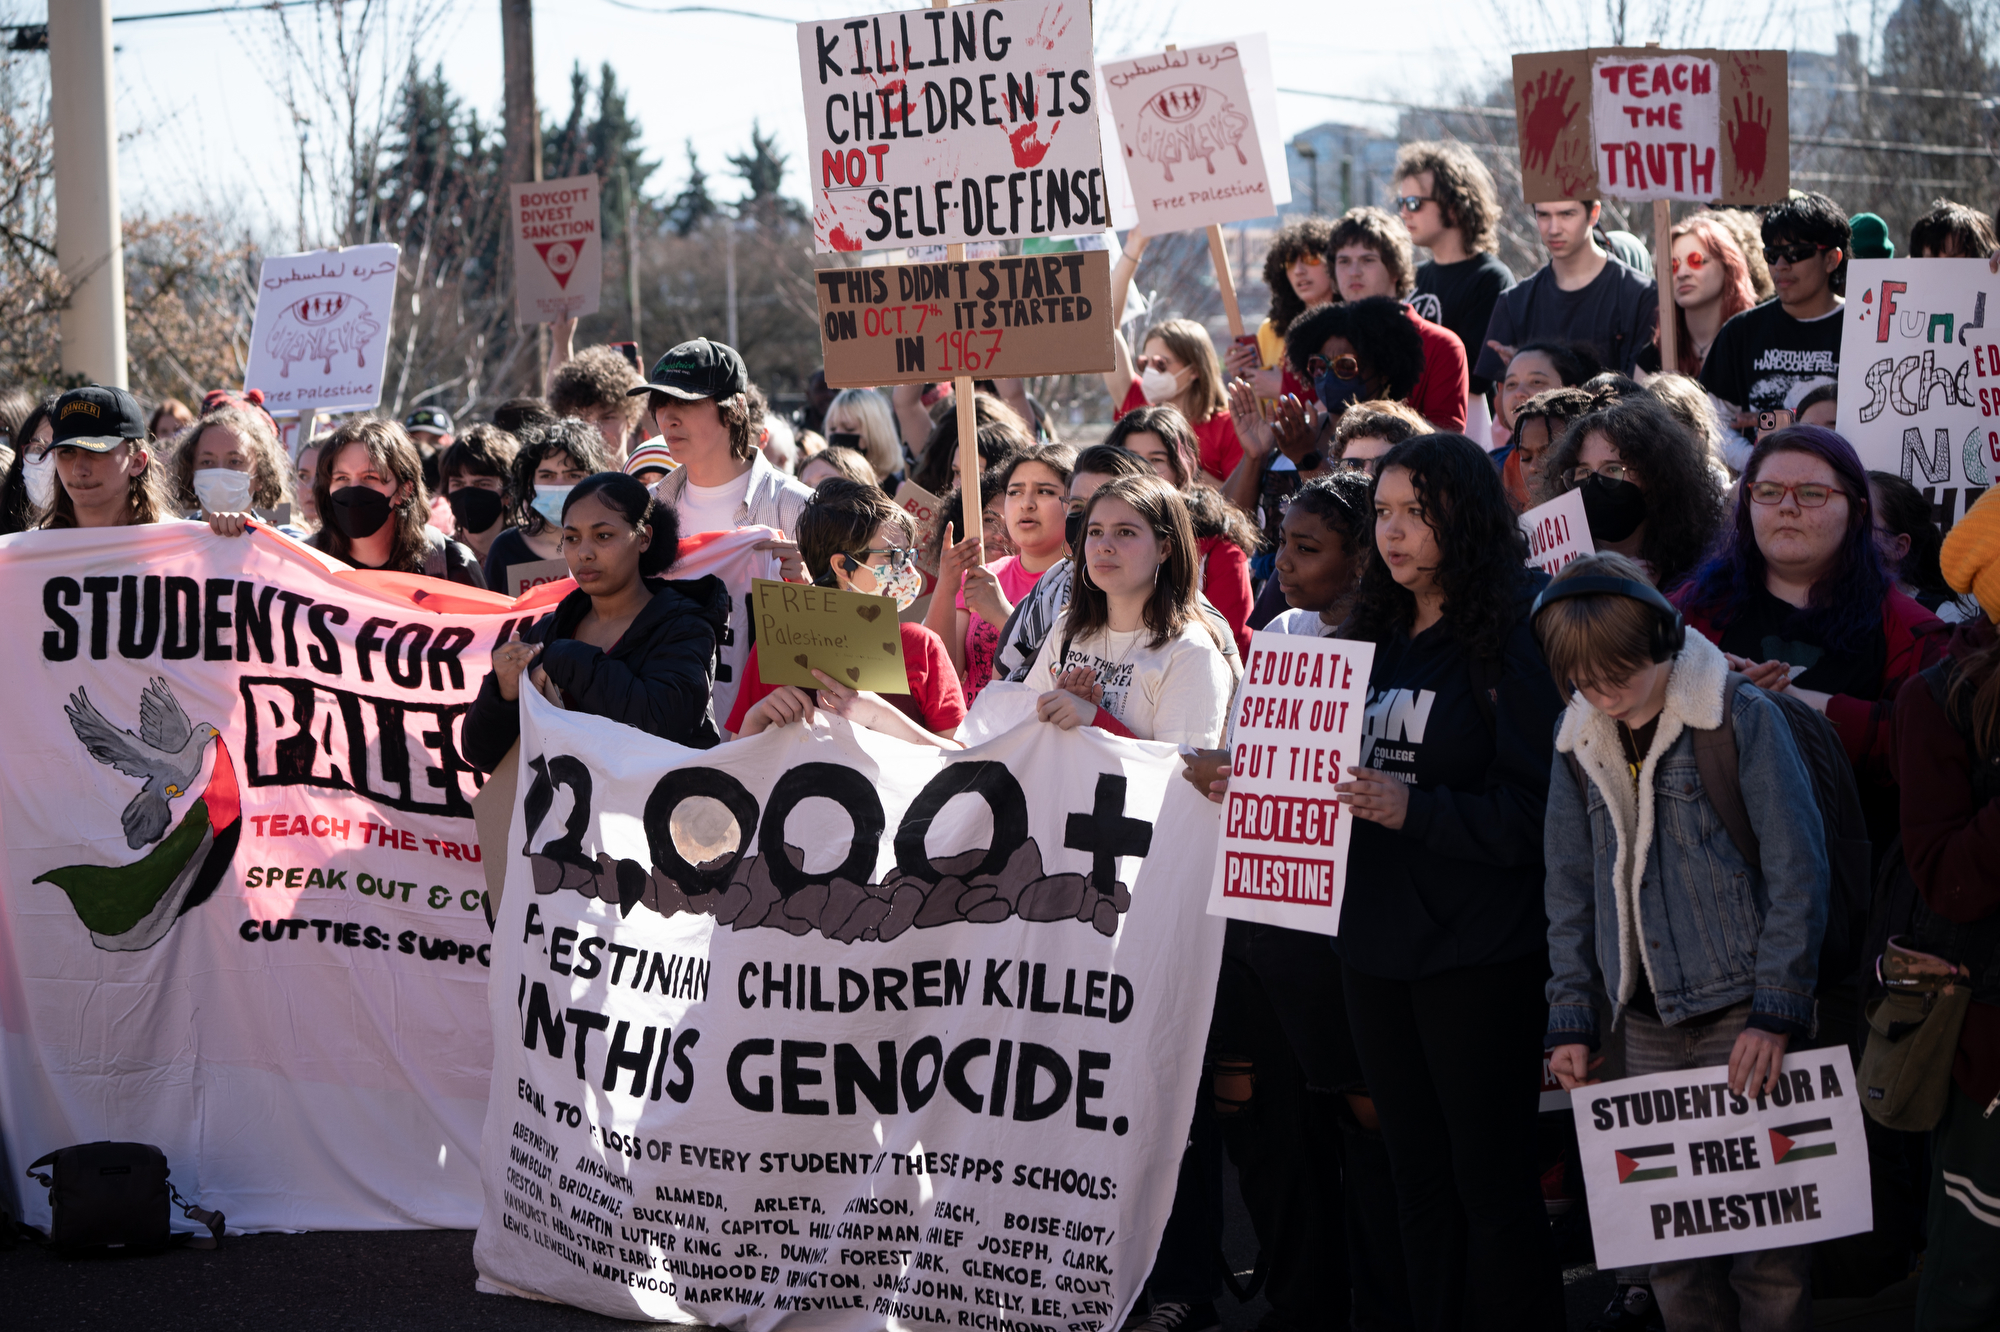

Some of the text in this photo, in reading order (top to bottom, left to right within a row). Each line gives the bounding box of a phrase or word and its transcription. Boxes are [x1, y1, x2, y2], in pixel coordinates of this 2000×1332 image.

[816, 9, 1012, 84] KILLING
[1600, 63, 1711, 98] TEACH
[826, 69, 1091, 145] CHILDREN IS
[1623, 102, 1683, 130] THE
[822, 144, 890, 188] NOT
[1601, 141, 1715, 195] TRUTH
[519, 188, 589, 207] BOYCOTT
[521, 206, 574, 223] DIVEST
[865, 167, 1106, 242] SELF-DEFENSE
[1152, 180, 1265, 211] Free Palestine
[522, 220, 594, 239] SANCTION
[819, 254, 1085, 304] THIS DIDN'T START
[825, 296, 1092, 341] ON OCT. 7th IT STARTED
[895, 329, 1004, 372] IN 1967
[1754, 358, 1840, 373] HARDCORE FEST
[62, 402, 97, 416] RANGER
[297, 381, 374, 400] Palestine
[760, 583, 837, 613] FREE
[43, 575, 349, 675] STUDENTS
[355, 617, 476, 691] FOR
[762, 613, 849, 649] Palestine!
[1249, 650, 1353, 689] EDUCATE
[1240, 696, 1349, 734] SPEAK OUT
[1233, 743, 1278, 780] CUT
[1289, 747, 1342, 784] TIES
[1373, 757, 1385, 768] OF
[1374, 747, 1415, 762] COLLEGE
[250, 814, 483, 864] TEACH THE TRU
[1229, 796, 1337, 842] PROTECT
[245, 867, 348, 891] SPEAK
[356, 873, 418, 904] OUT
[427, 884, 453, 910] &
[1227, 855, 1331, 902] PALESTINE
[239, 919, 492, 968] CUT TIES: SUPPO
[738, 957, 972, 1013] CHILDREN
[981, 957, 1134, 1024] KILLED
[726, 1035, 1130, 1136] GENOCIDE.
[1591, 1064, 1843, 1131] STUDENTS FOR A
[554, 1100, 582, 1129] TO
[601, 1126, 642, 1160] LOSS
[646, 1139, 672, 1163] OF
[680, 1144, 751, 1173] EVERY
[759, 1151, 873, 1174] STUDENT
[891, 1152, 960, 1178] THESE
[961, 1156, 1004, 1184] PPS
[1012, 1164, 1117, 1200] SCHOOLS:
[1688, 1135, 1760, 1176] FREE
[512, 1121, 559, 1164] ABERNETHY,
[656, 1186, 728, 1212] ALAMEDA,
[754, 1196, 826, 1215] ARLETA,
[934, 1200, 980, 1226] BEACH,
[507, 1166, 544, 1205] CRESTON,
[570, 1205, 613, 1238] MARTIN
[621, 1226, 676, 1252] LUTHER
[684, 1237, 721, 1257] KING
[734, 1243, 768, 1260] JR.,
[841, 1249, 912, 1267] FOREST
[962, 1259, 1046, 1290] GLENCOE,
[1055, 1274, 1115, 1299] GROUT,
[559, 1174, 623, 1220] BRIDLEMILE,
[632, 1207, 710, 1234] BUCKMAN,
[721, 1219, 799, 1236] CAPITOL
[836, 1221, 923, 1244] CHAPMAN,
[977, 1235, 1052, 1264] JOSEPH,
[1063, 1248, 1114, 1275] CLARK,
[1650, 1183, 1821, 1240] PALESTINE
[503, 1213, 531, 1241] LEWIS,
[534, 1229, 589, 1275] LLEWELLYN,
[593, 1262, 678, 1302] MAPLEWOOD,
[685, 1287, 765, 1308] MARKHAM,
[873, 1297, 951, 1324] PENINSULA,
[552, 1216, 575, 1242] HEAD
[576, 1234, 615, 1259] START
[619, 1247, 657, 1269] EARLY
[662, 1258, 756, 1280] CHILDHOOD
[761, 1265, 780, 1285] ED,
[912, 1279, 967, 1304] JOHN,
[975, 1286, 1025, 1314] KELLY,
[1032, 1297, 1067, 1319] LEE,
